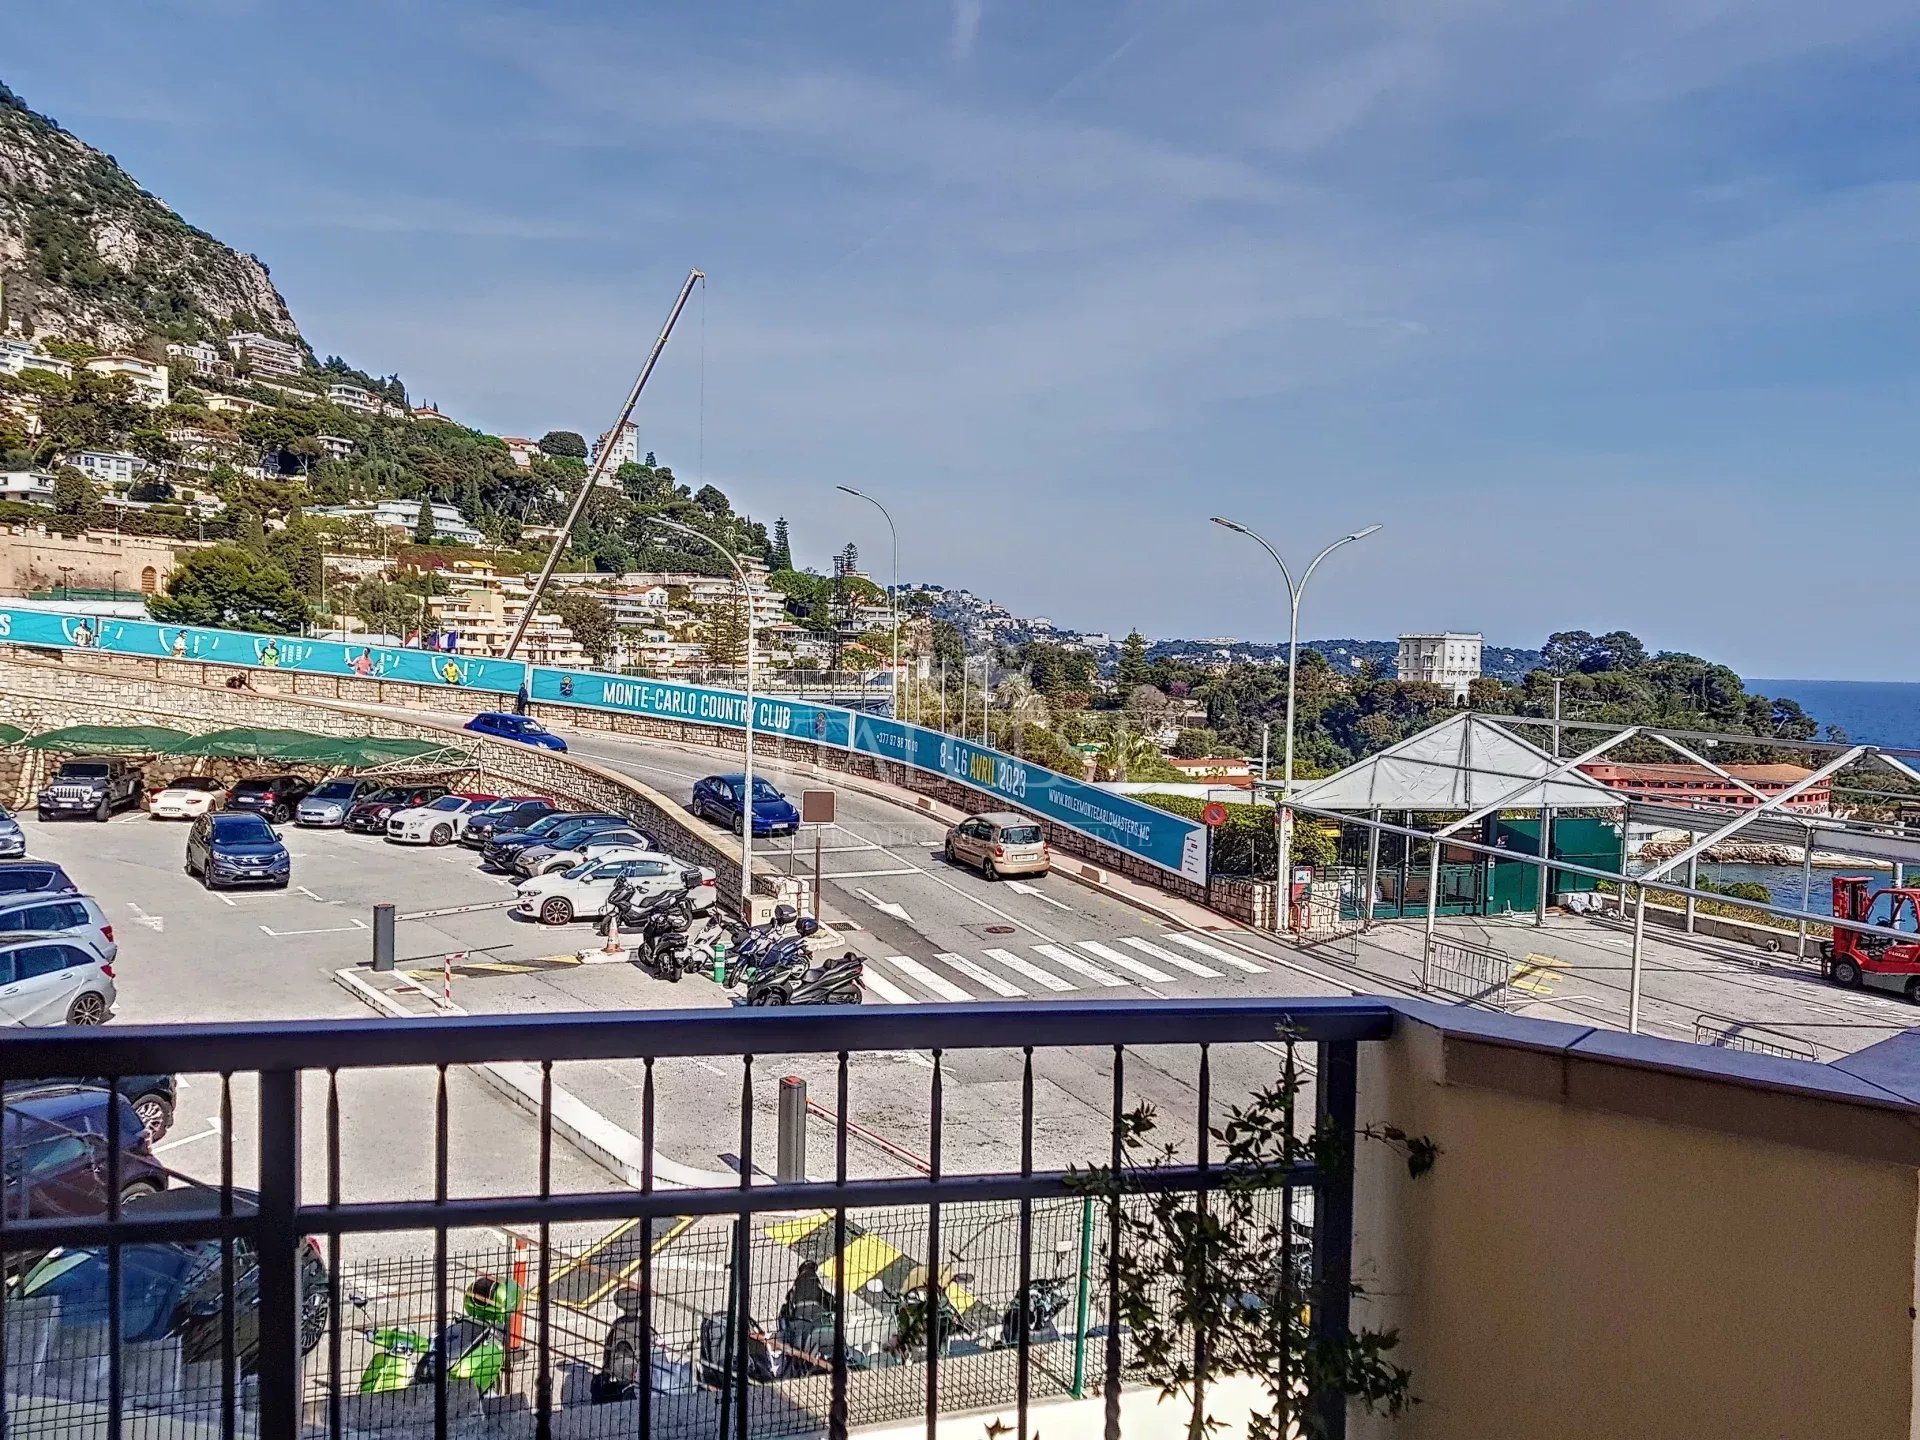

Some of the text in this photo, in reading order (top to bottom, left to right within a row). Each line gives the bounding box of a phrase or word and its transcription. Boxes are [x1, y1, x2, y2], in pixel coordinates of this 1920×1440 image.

[602, 681, 791, 730] MONTE-CARLO COUNTRY CLUB
[969, 752, 997, 788] AVRIL
[999, 762, 1027, 798] 2023
